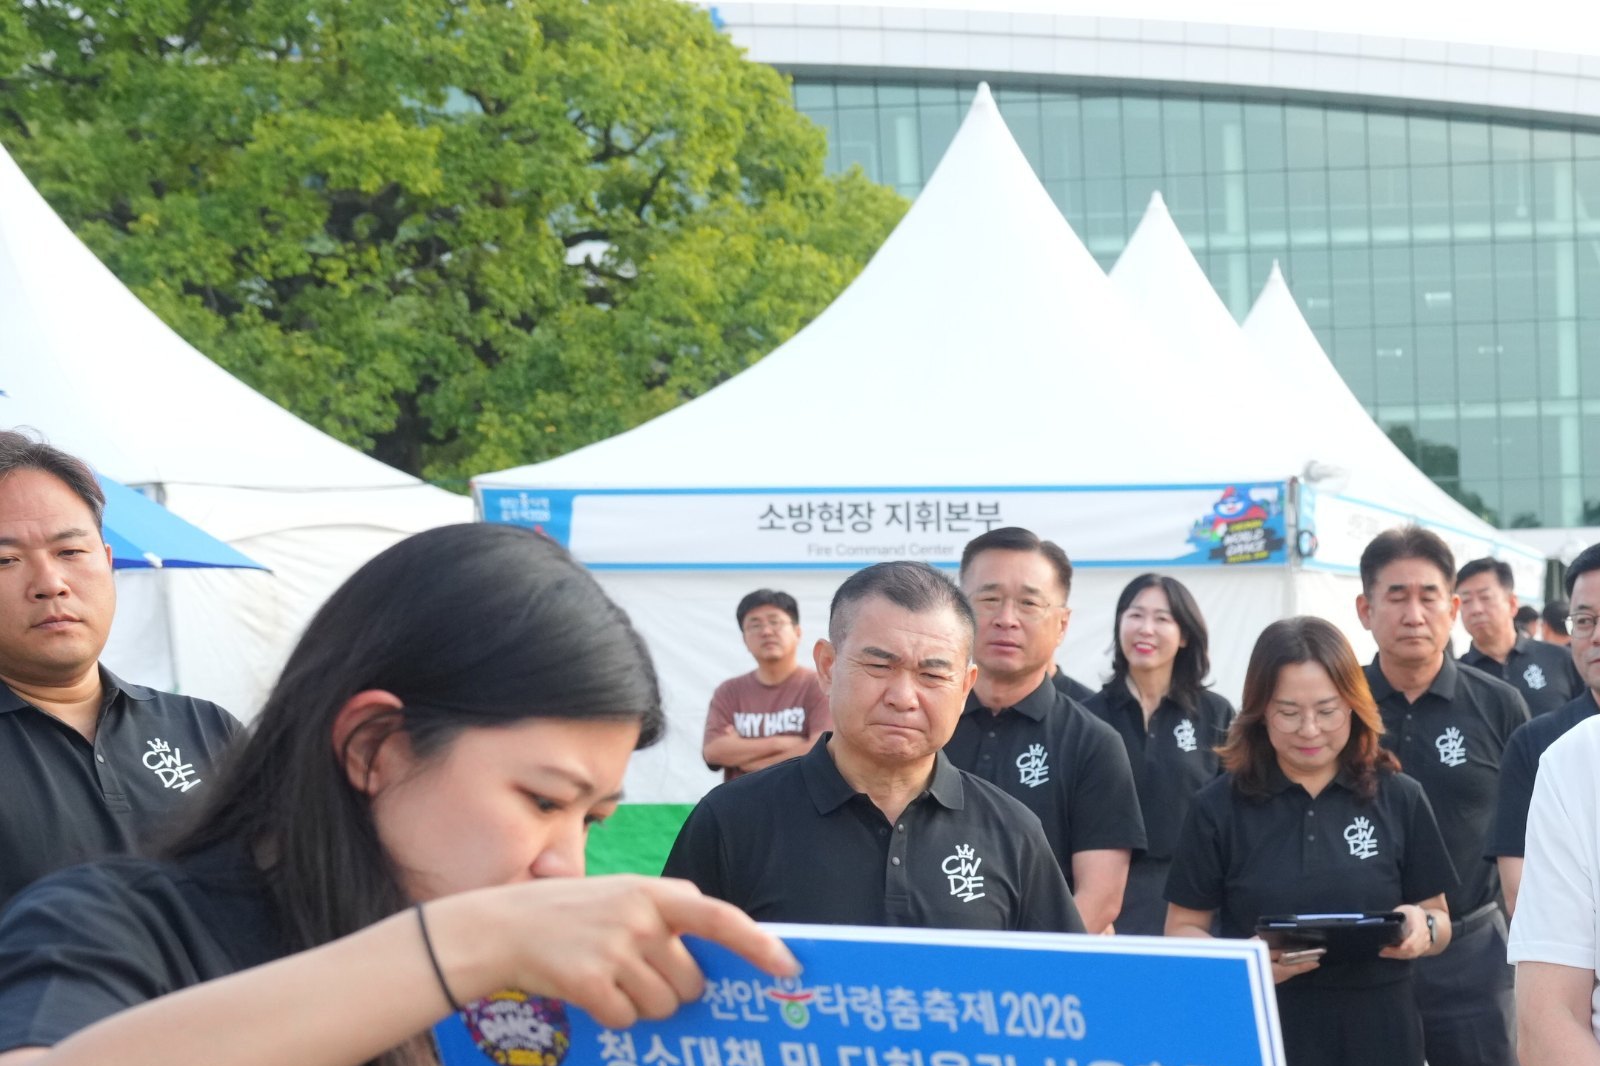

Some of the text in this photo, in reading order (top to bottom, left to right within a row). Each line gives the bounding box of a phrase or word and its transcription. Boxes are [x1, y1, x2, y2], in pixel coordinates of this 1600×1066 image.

[757, 499, 1003, 534] 소방현장 지휘본부
[807, 543, 954, 557] Fire Command Center
